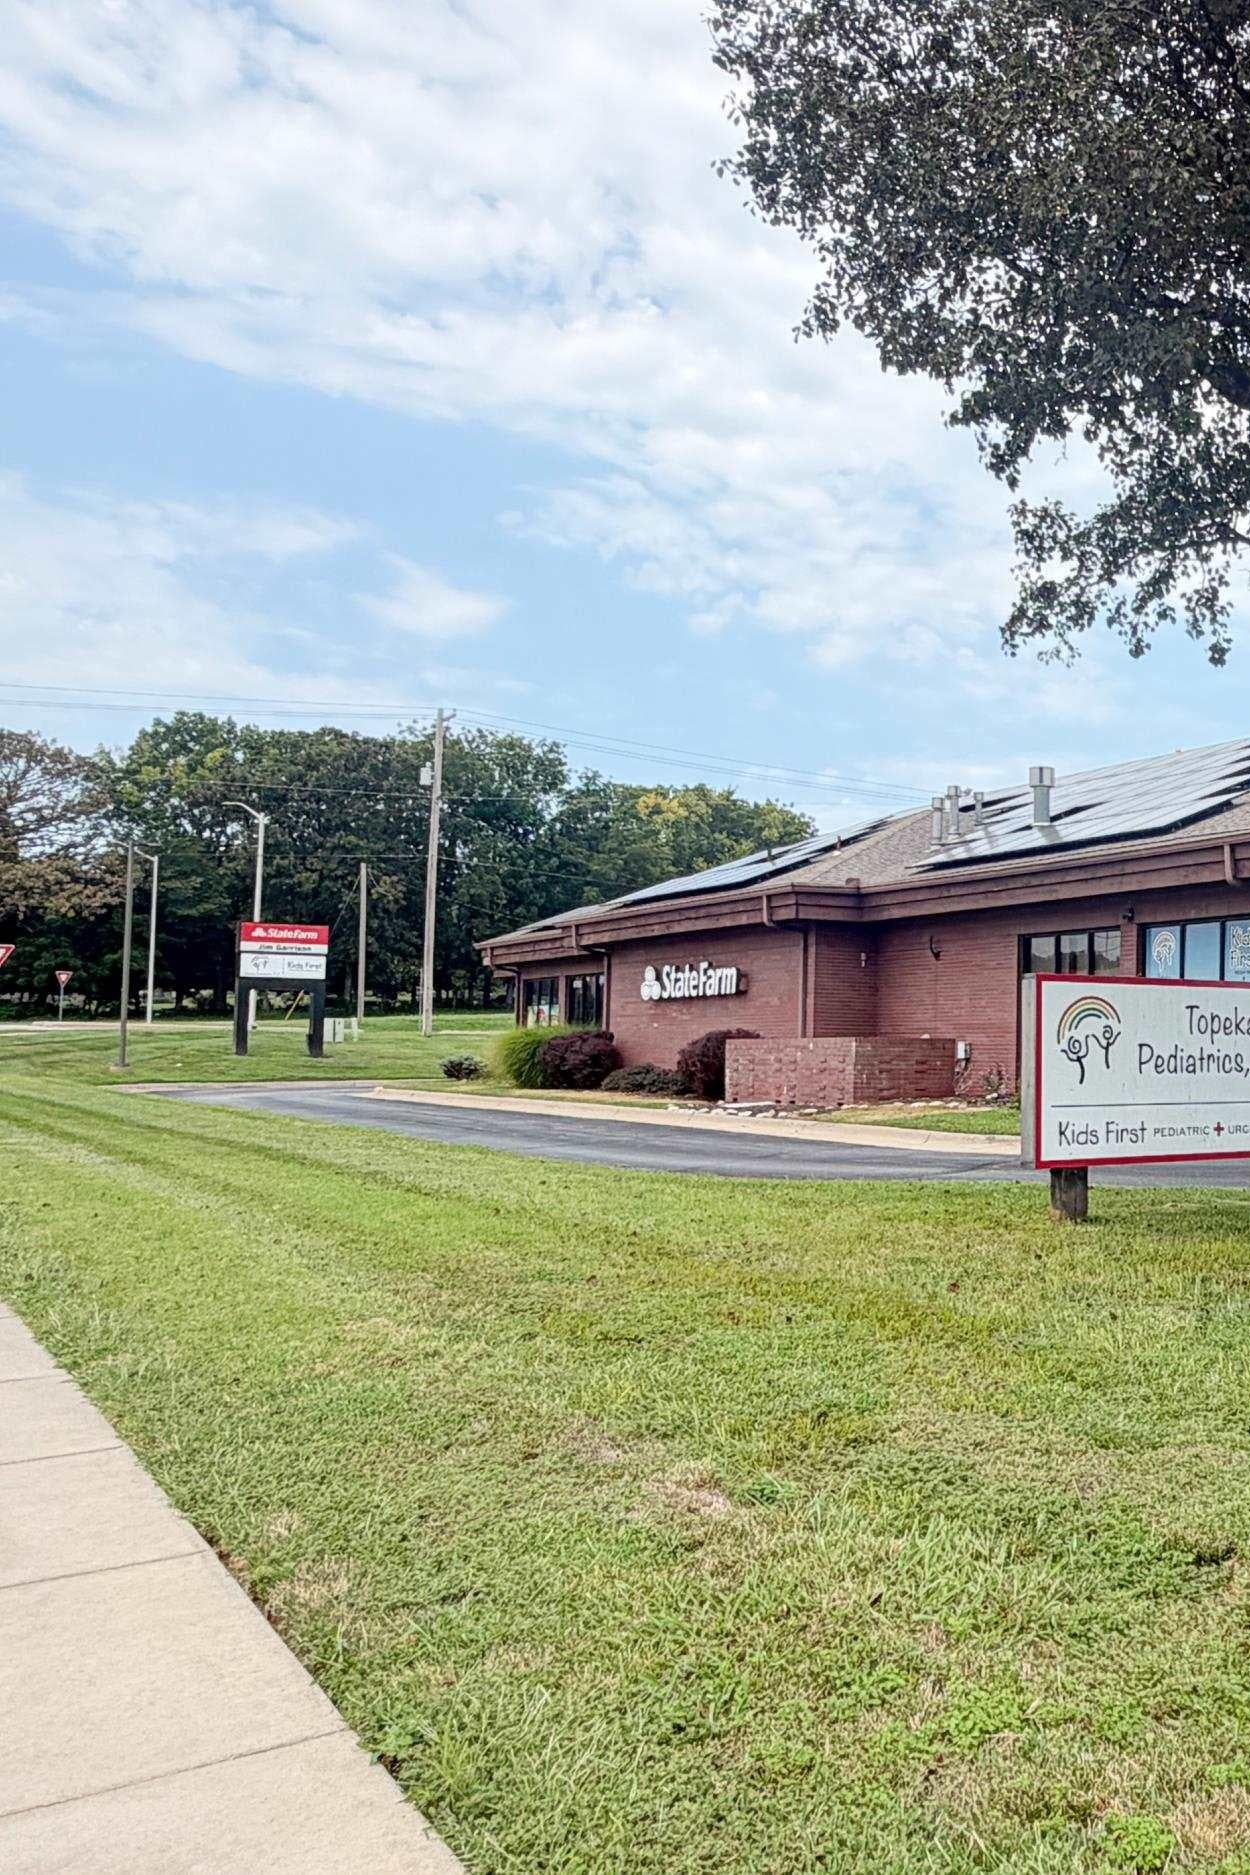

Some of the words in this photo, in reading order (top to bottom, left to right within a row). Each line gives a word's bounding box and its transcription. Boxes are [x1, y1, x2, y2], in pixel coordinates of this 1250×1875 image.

[1138, 1043, 1250, 1077] Pediatrics,
[1058, 1121, 1099, 1147] Kids
[1106, 1121, 1147, 1144] First
[1153, 1125, 1210, 1138] PEDIATRIC
